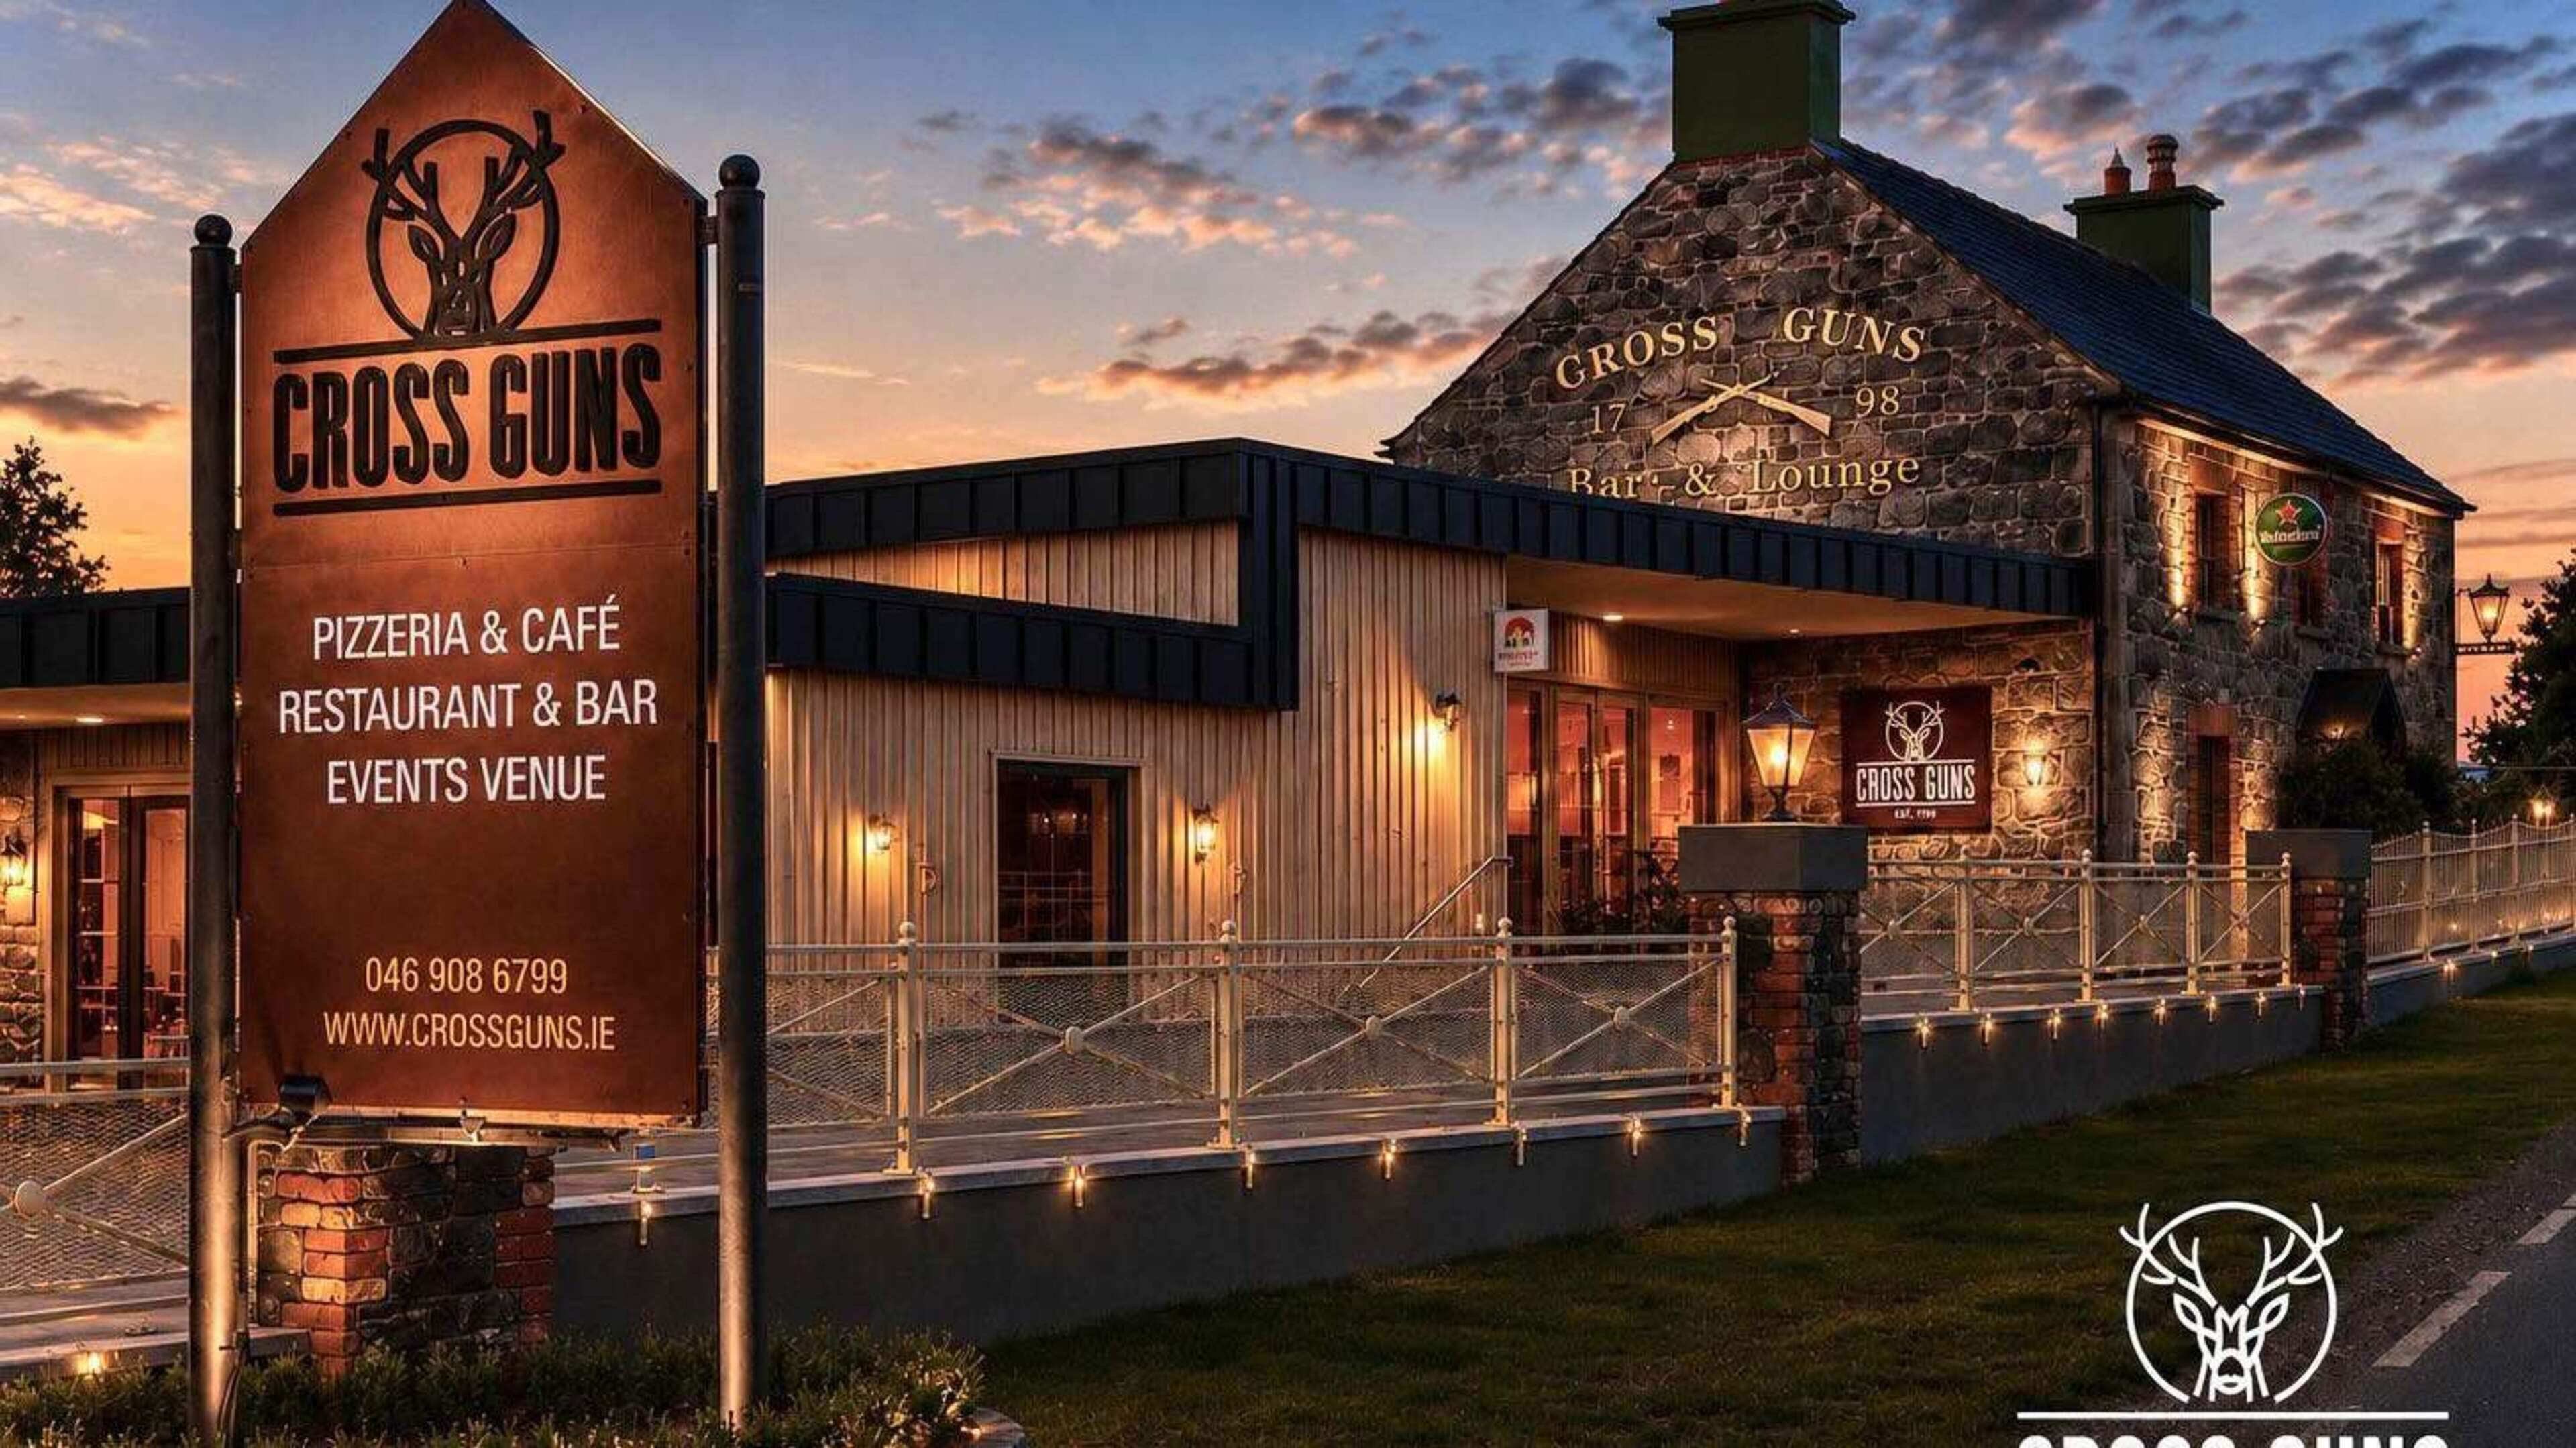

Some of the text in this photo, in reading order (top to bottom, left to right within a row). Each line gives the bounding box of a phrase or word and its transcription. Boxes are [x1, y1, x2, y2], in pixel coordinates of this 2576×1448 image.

[1783, 307, 1925, 362] GUNS
[274, 343, 661, 493] CROSS GUNS
[1591, 386, 1900, 434] 17 98
[1684, 463, 1717, 496] &
[1748, 457, 1919, 495] Lounge
[313, 594, 620, 661] PIZZERIA & CAFÉ
[279, 679, 657, 734] RESTAURANT & BAR
[327, 755, 605, 804] EVENTS VENUE
[1856, 765, 1976, 801] CROSS GUNS
[366, 956, 568, 994] 046 908 6799
[324, 1011, 615, 1050] WWW.CROSSGUNS.IE
